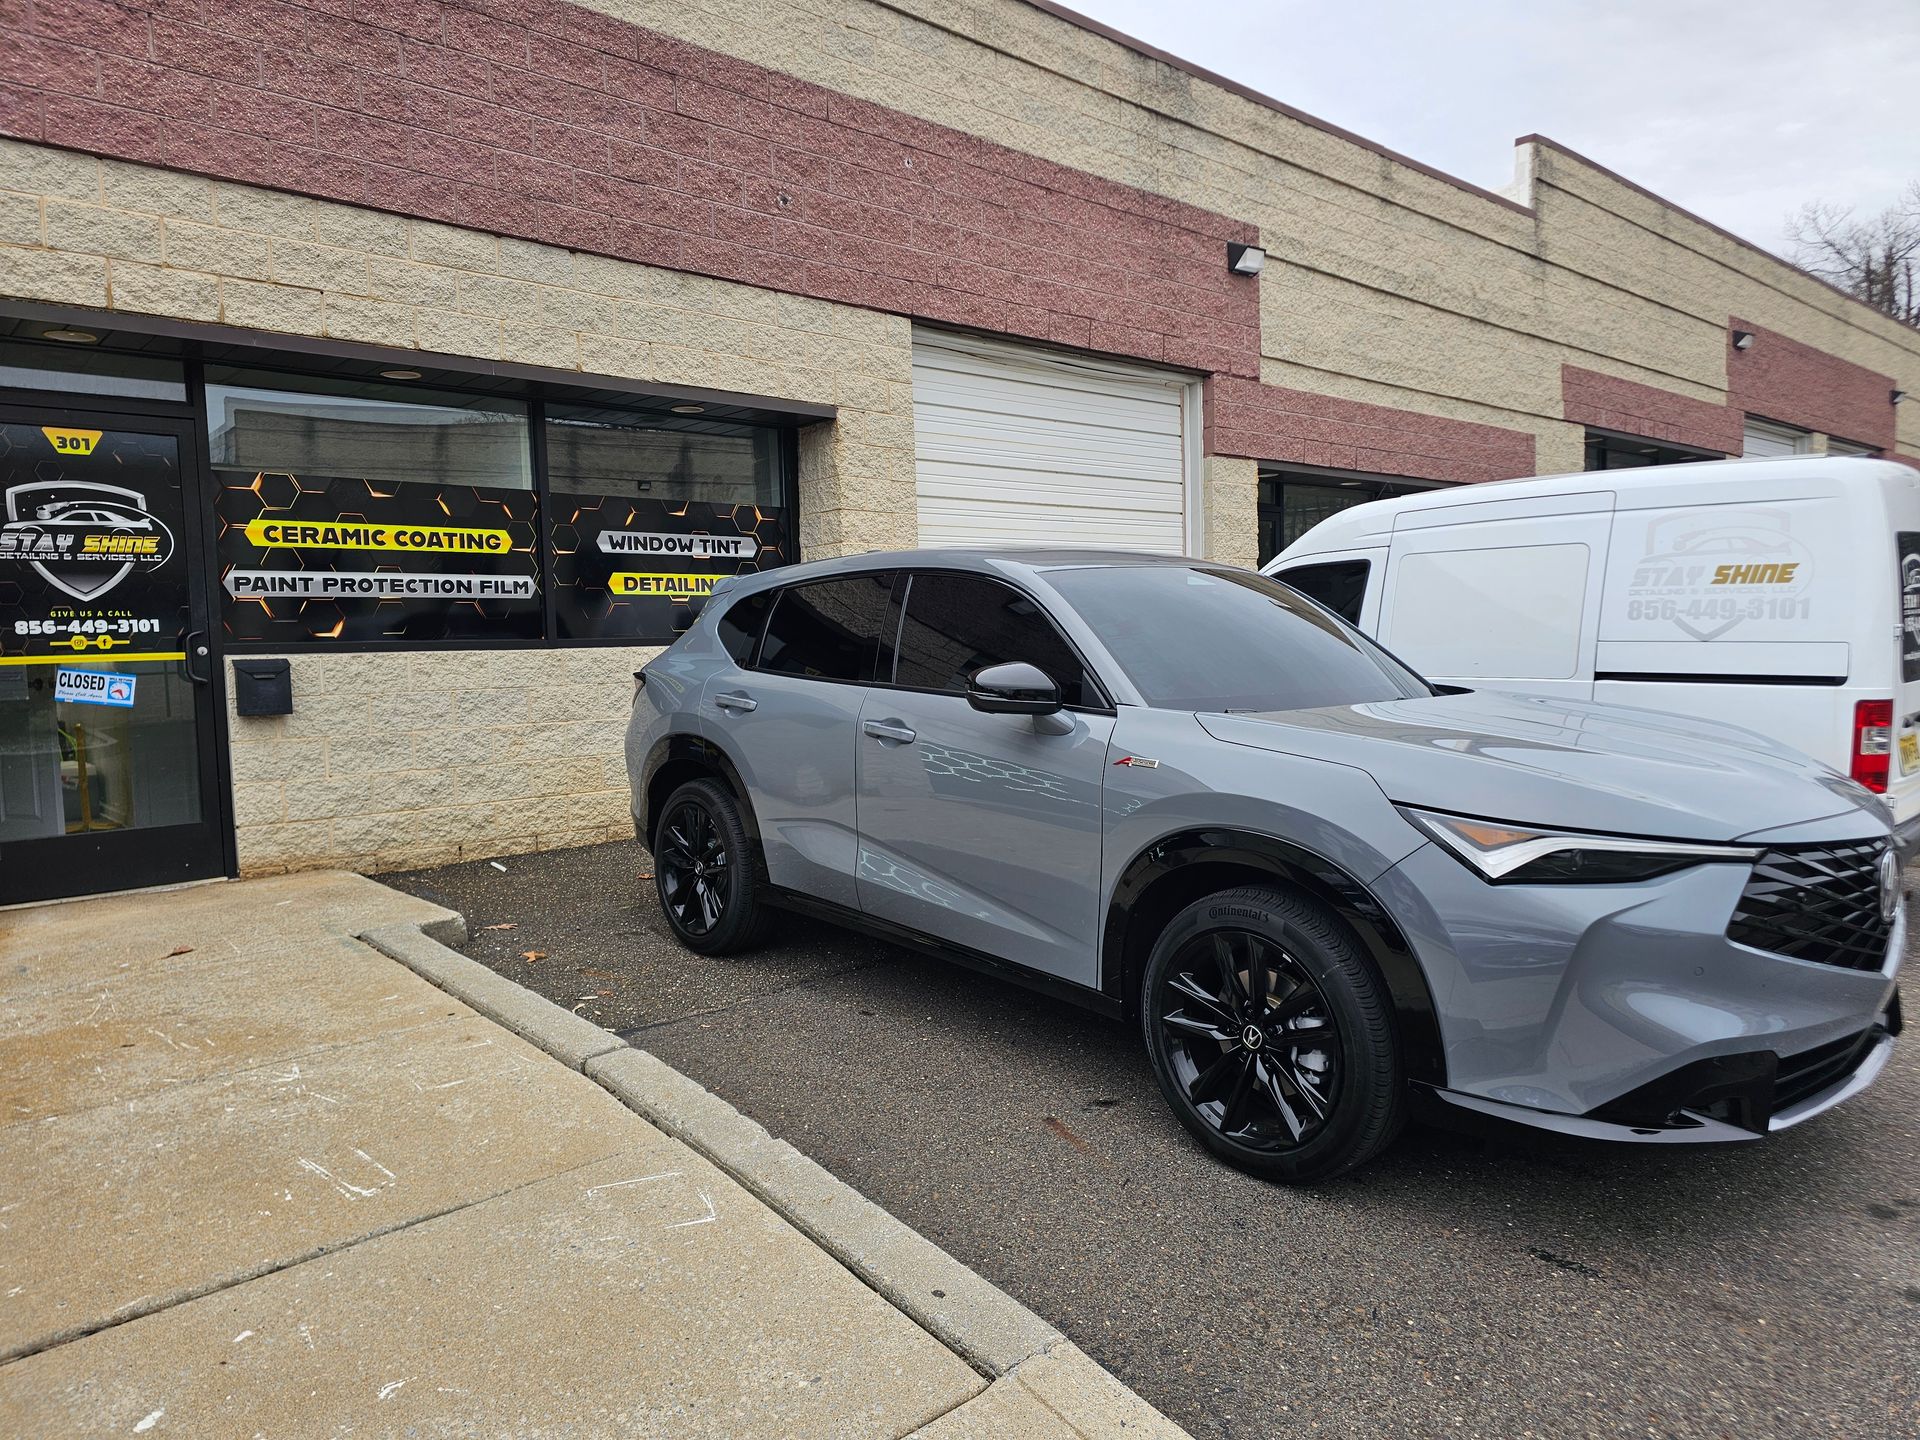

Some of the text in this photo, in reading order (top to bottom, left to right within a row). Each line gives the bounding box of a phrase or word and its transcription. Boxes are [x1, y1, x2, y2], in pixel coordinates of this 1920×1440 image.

[55, 435, 92, 452] 301
[0, 532, 160, 554] STAY SHINE
[262, 525, 502, 550] CERAMIC COATING
[607, 534, 742, 555] WINDOW TINT
[0, 552, 59, 560] DETAILING
[76, 553, 136, 562] SERVICES,
[140, 554, 162, 562] LLC
[1630, 562, 1800, 587] STAY SHINE
[233, 576, 530, 595] PAINT PROTECTION FILM
[623, 576, 720, 593] DETAILIN
[50, 610, 75, 618] GIVE
[1627, 597, 1810, 621] 856-449-3101
[14, 618, 160, 635] 856-449-3101
[59, 672, 105, 691] CLOSED
